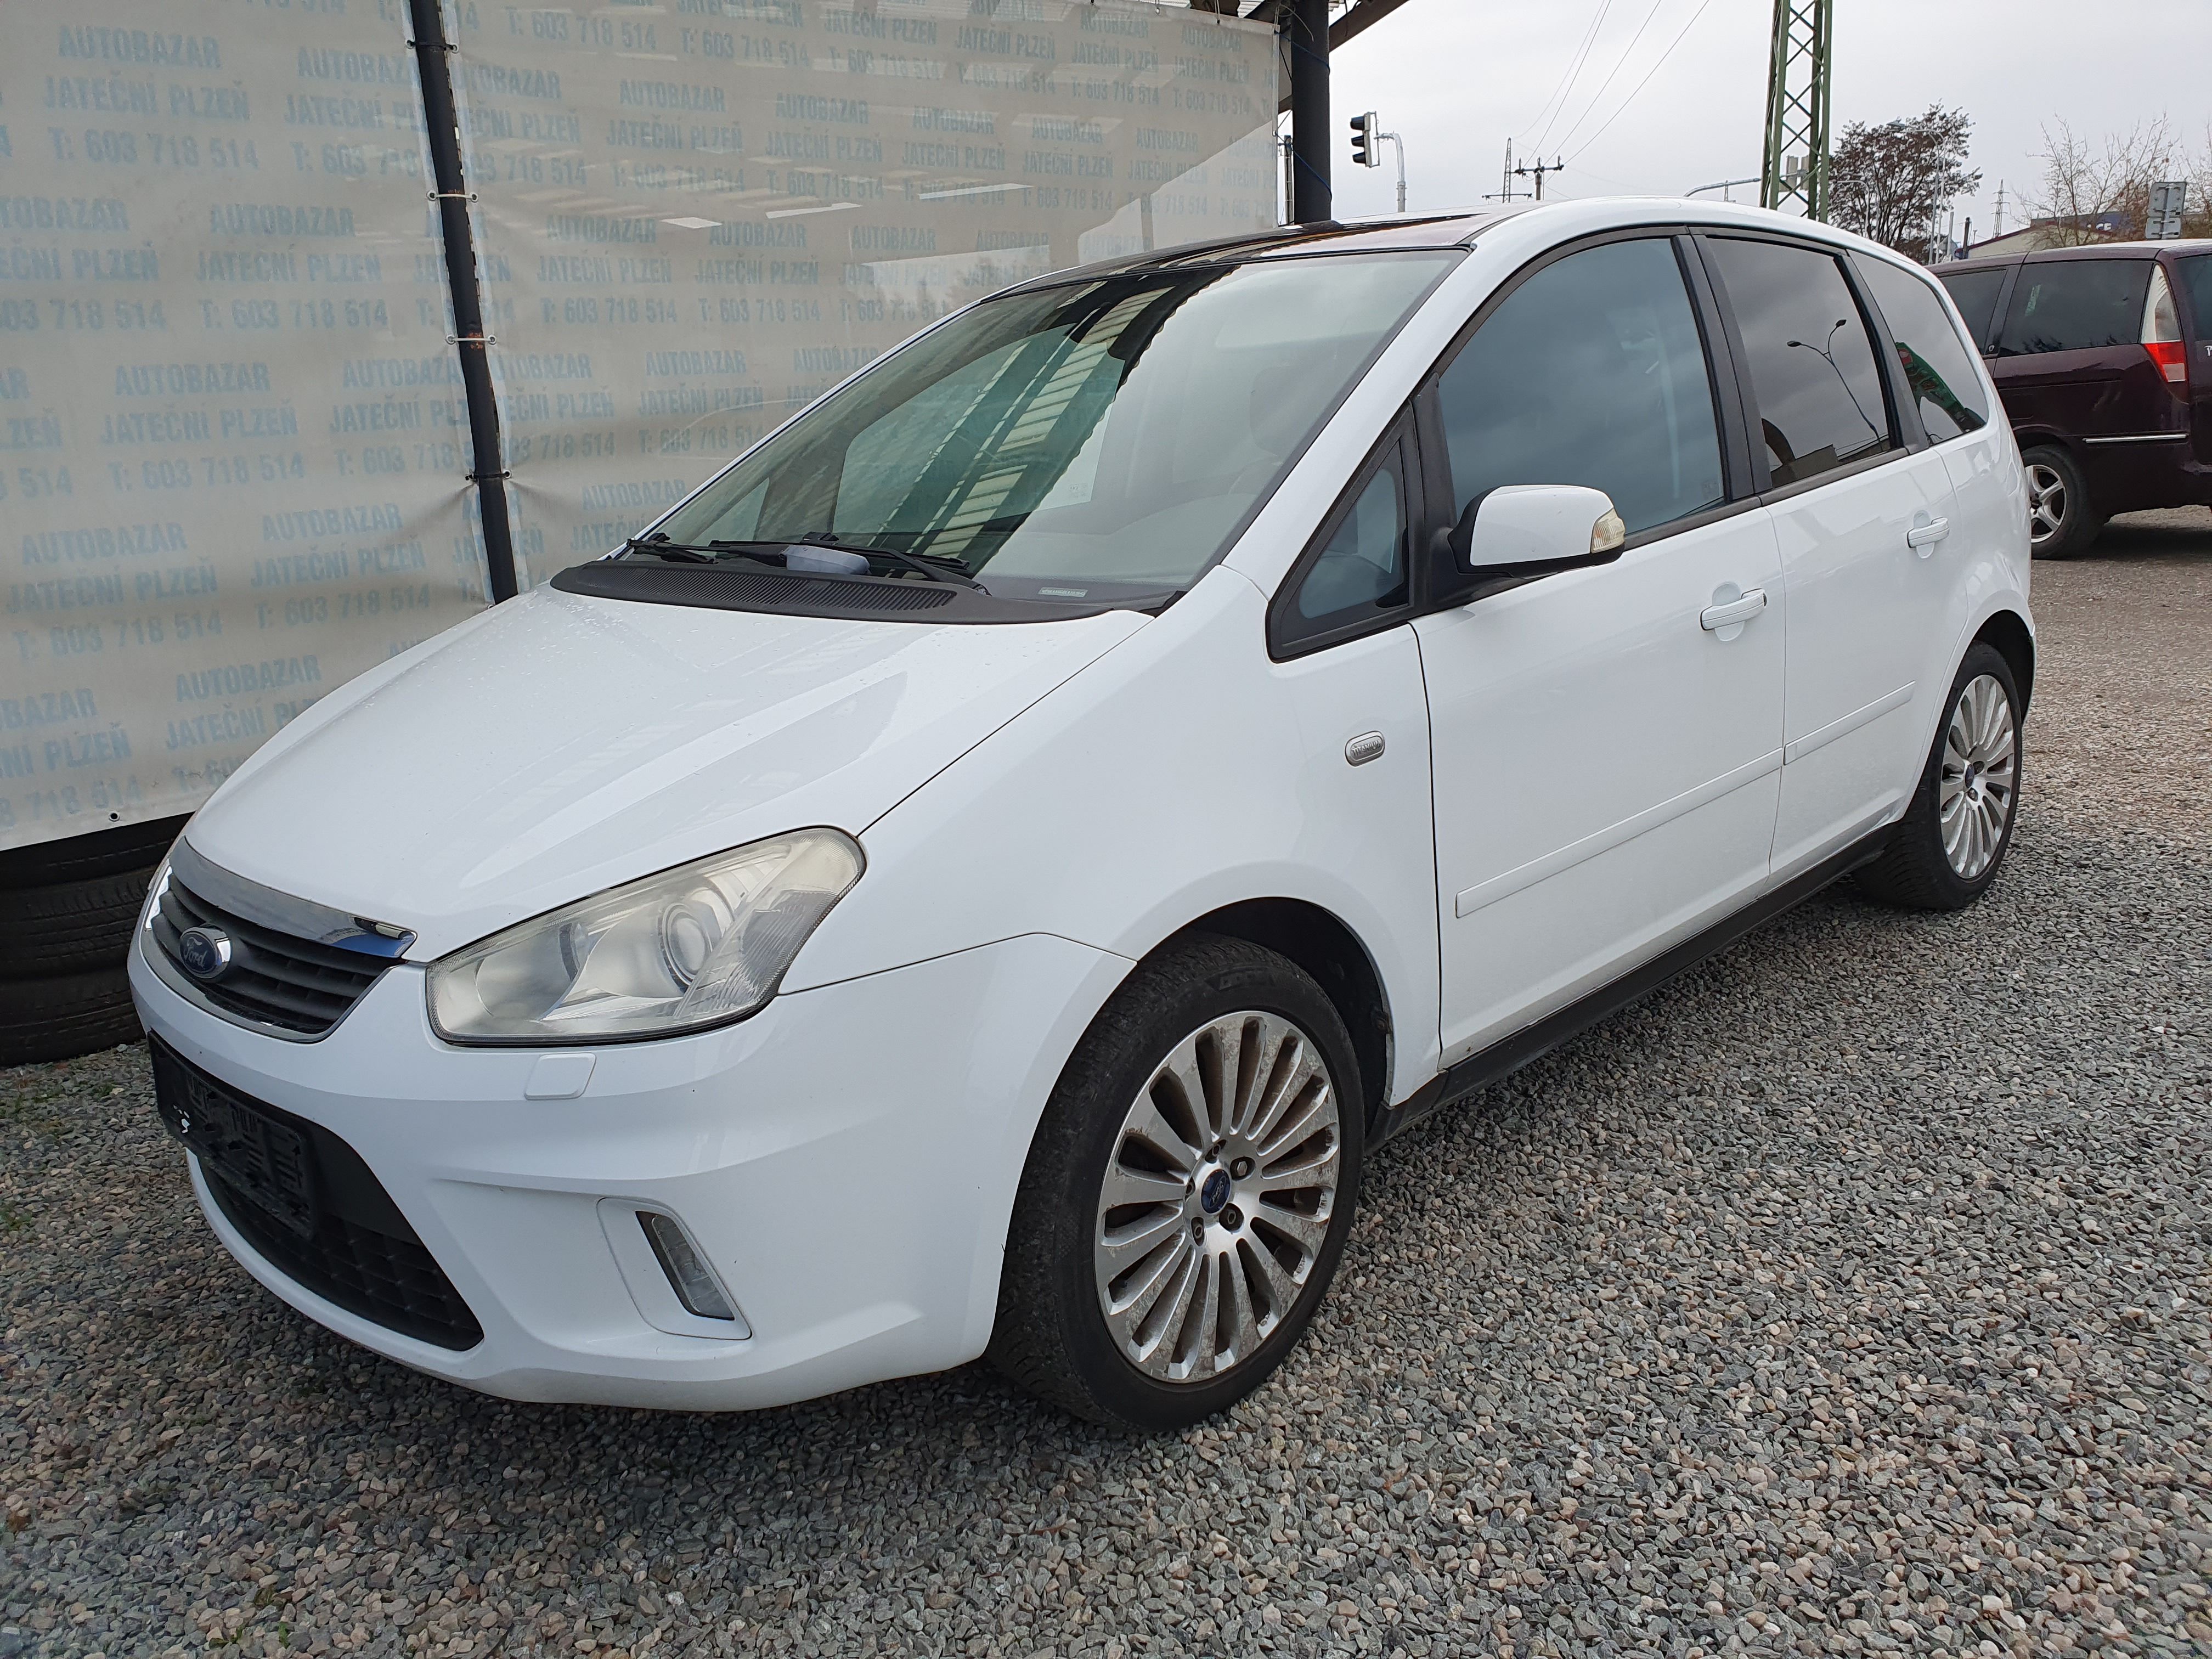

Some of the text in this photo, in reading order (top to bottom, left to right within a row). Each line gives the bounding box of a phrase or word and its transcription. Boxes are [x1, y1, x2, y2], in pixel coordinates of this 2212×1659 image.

[505, 6, 524, 36] T:
[531, 12, 569, 41] 603
[576, 16, 614, 46] 718
[622, 21, 657, 50] 514
[58, 25, 221, 70] AUTOBAZAR
[682, 27, 809, 67] T: 603 718 514
[1017, 32, 1056, 60] PLZEŇ
[168, 80, 250, 122] PLZEŇ
[619, 78, 726, 112] AUTOBAZAR
[776, 92, 869, 125] AUTOBAZAR
[47, 127, 76, 161] T:
[85, 128, 137, 163] 603
[146, 132, 199, 167] 718
[210, 137, 259, 171] 514
[690, 121, 743, 153] PLZEŇ
[837, 132, 882, 162] PLZEŇ
[1136, 127, 1199, 152] AUTOBAZAR
[505, 155, 543, 184] 718
[551, 156, 587, 185] 514
[965, 143, 1005, 171] PLZEŇ
[1078, 152, 1113, 178] PLZEŇ
[788, 171, 816, 197] 603
[823, 172, 850, 198] 718
[1037, 187, 1059, 208] 603
[1065, 188, 1086, 210] 718
[1092, 190, 1112, 210] 514
[0, 196, 130, 230] TOBAZAR
[211, 202, 356, 237] AUTOBAZAR
[546, 214, 657, 244] AUTOBAZAR
[709, 221, 806, 247] AUTOBAZAR
[852, 225, 936, 251] AUTOBAZAR
[619, 251, 672, 284] PLZEŇ
[771, 255, 819, 285] PLZEŇ
[0, 298, 167, 332] 03 718 514
[198, 298, 387, 329] T: 603 718 514
[541, 297, 678, 324] T: 603 718 514
[698, 298, 821, 324] T: 603 718 514
[856, 298, 884, 323] 603
[116, 362, 270, 396] AUTOBAZAR
[343, 356, 462, 388] AUTOBAZA
[646, 351, 746, 377] AUTOBAZAR
[221, 398, 298, 439] PLZEŇ
[330, 393, 421, 433] JATEČNÍ
[557, 386, 615, 419] PLZEŇ
[0, 407, 63, 451] ZEŇ
[541, 431, 615, 459] 718 514
[638, 430, 653, 453] T:
[107, 452, 305, 493] T: 603 718 514
[334, 447, 353, 476] T:
[363, 446, 405, 475] 603
[414, 443, 454, 470] 718
[18, 465, 74, 500] 514
[263, 503, 404, 540] AUTOBAZAR
[22, 522, 189, 565] AUTOBAZAR
[357, 534, 426, 578] PLZEŇ
[255, 583, 430, 629] T: 603 718 514
[13, 609, 223, 659] T: 603 718 514
[176, 654, 322, 702] AUTOBAZAR
[0, 688, 98, 729] BAZAR
[44, 721, 132, 769] PLZEŇ
[184, 936, 208, 969] Ford
